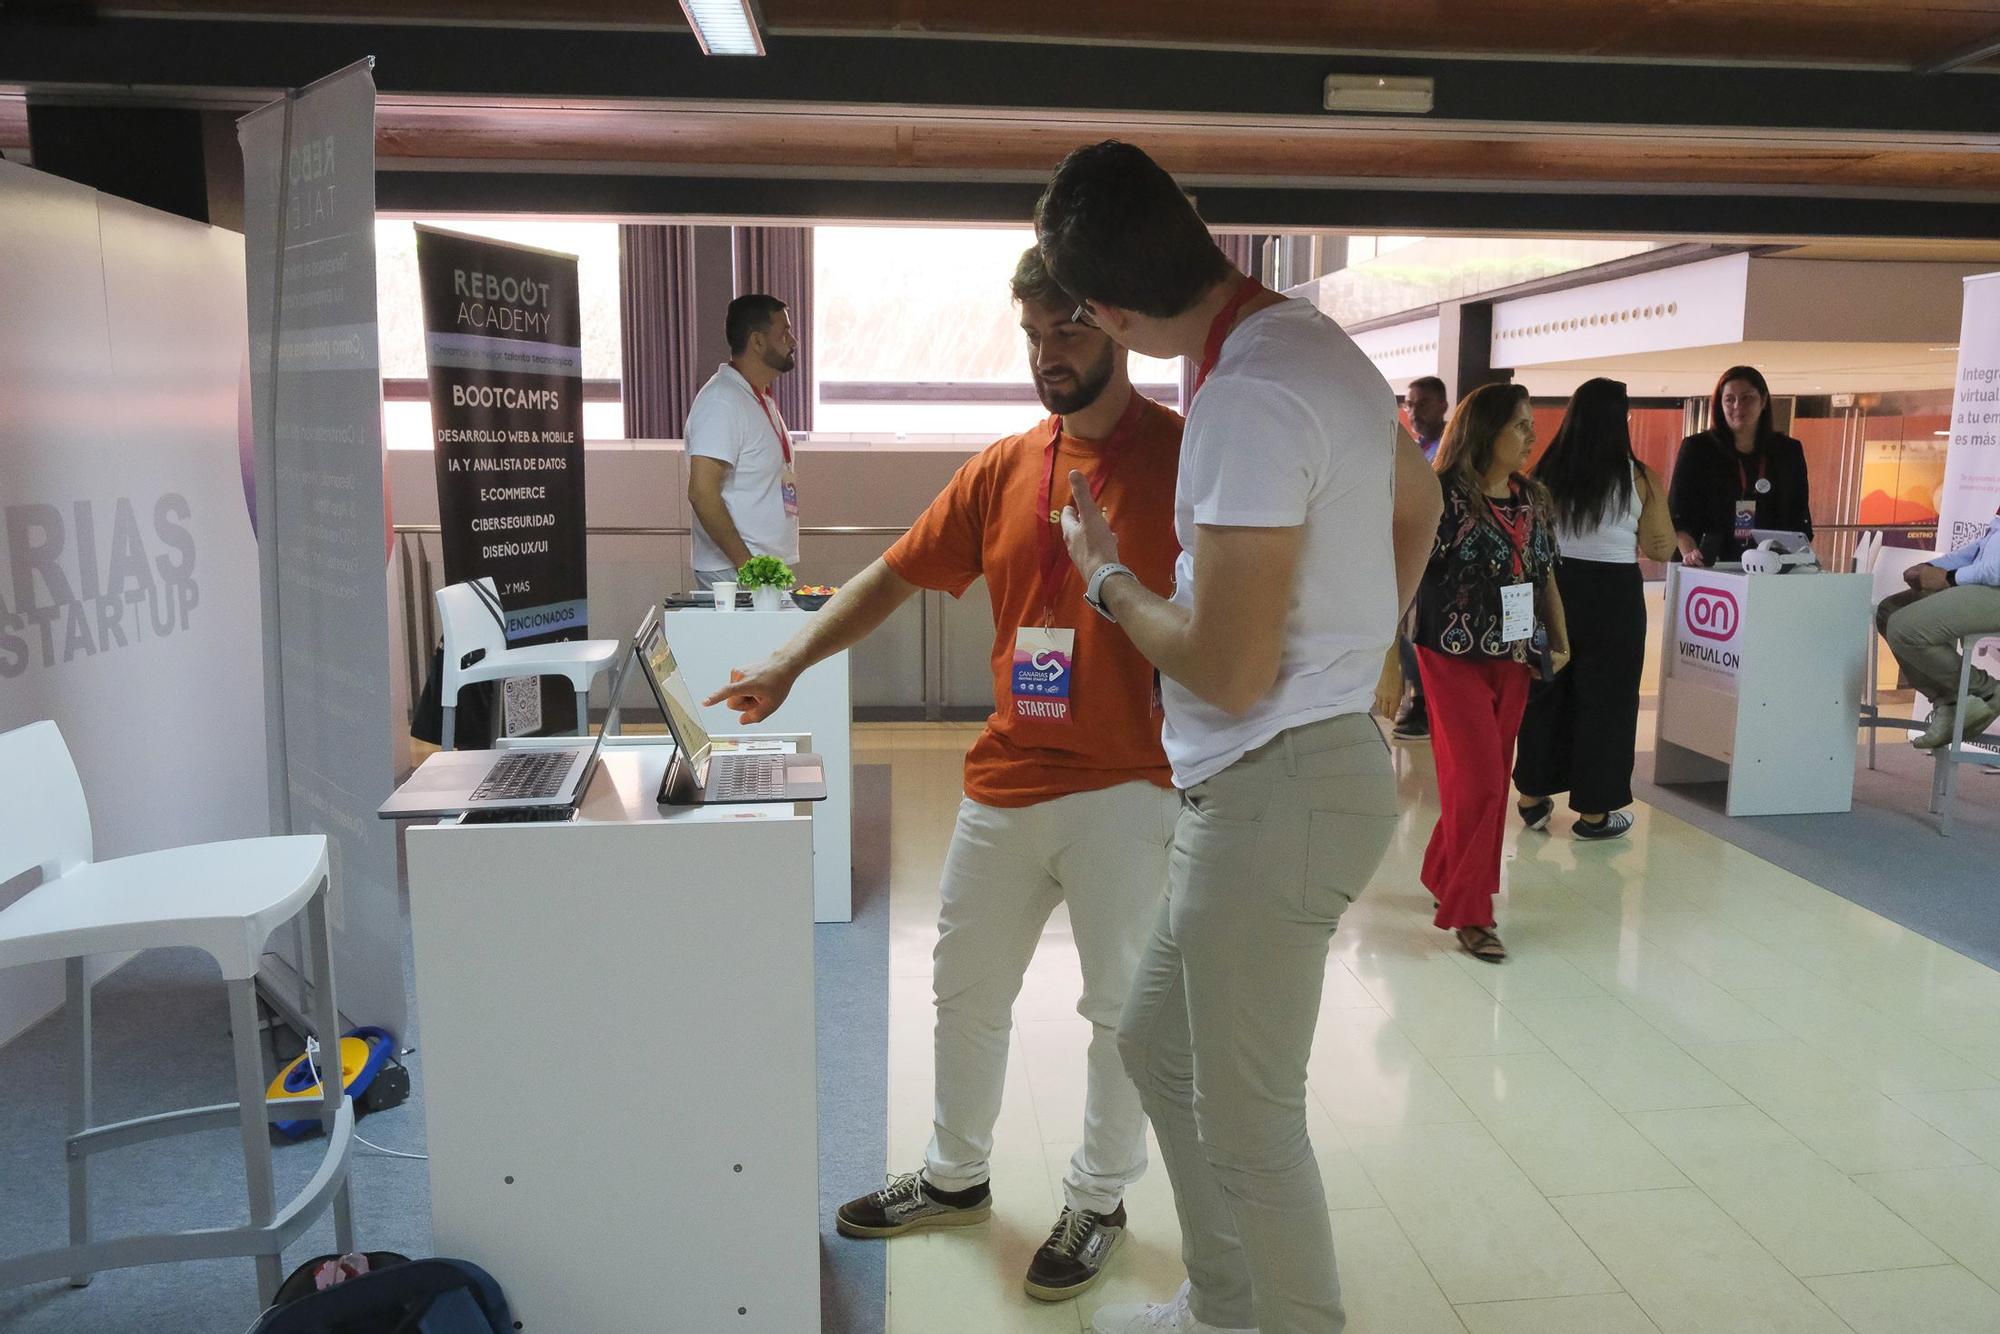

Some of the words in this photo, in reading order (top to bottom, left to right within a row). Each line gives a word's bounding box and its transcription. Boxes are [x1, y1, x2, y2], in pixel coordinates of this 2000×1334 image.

[454, 269, 549, 308] REBOOT
[457, 302, 550, 334] ACADEMY
[1962, 367, 2000, 384] Integr
[452, 385, 559, 410] BOOTCAMPS
[1961, 387, 2000, 402] virtual
[1957, 413, 1965, 424] a
[1968, 410, 1980, 424] tu
[438, 429, 507, 443] DESARROLLO
[508, 431, 530, 443] WEB
[532, 431, 540, 443] &
[541, 431, 574, 443] MOBILE
[1955, 434, 1968, 446] es
[1971, 431, 1996, 446] más
[448, 458, 461, 472] IA
[463, 458, 471, 472] Y
[473, 458, 522, 471] ANALISTA
[523, 458, 537, 470] DE
[538, 457, 567, 470] DATOS
[480, 486, 546, 501] E-COMMERCE
[471, 514, 556, 532] CIBERSEGURIDAD
[0, 493, 196, 615] RIAS
[482, 541, 520, 559] DISEÑO
[520, 540, 549, 554] UX/UI
[0, 578, 199, 679] STARTUP
[1680, 641, 1721, 664] VIRTUAL
[1722, 652, 1740, 669] ON
[1017, 700, 1066, 719] STARTUP
